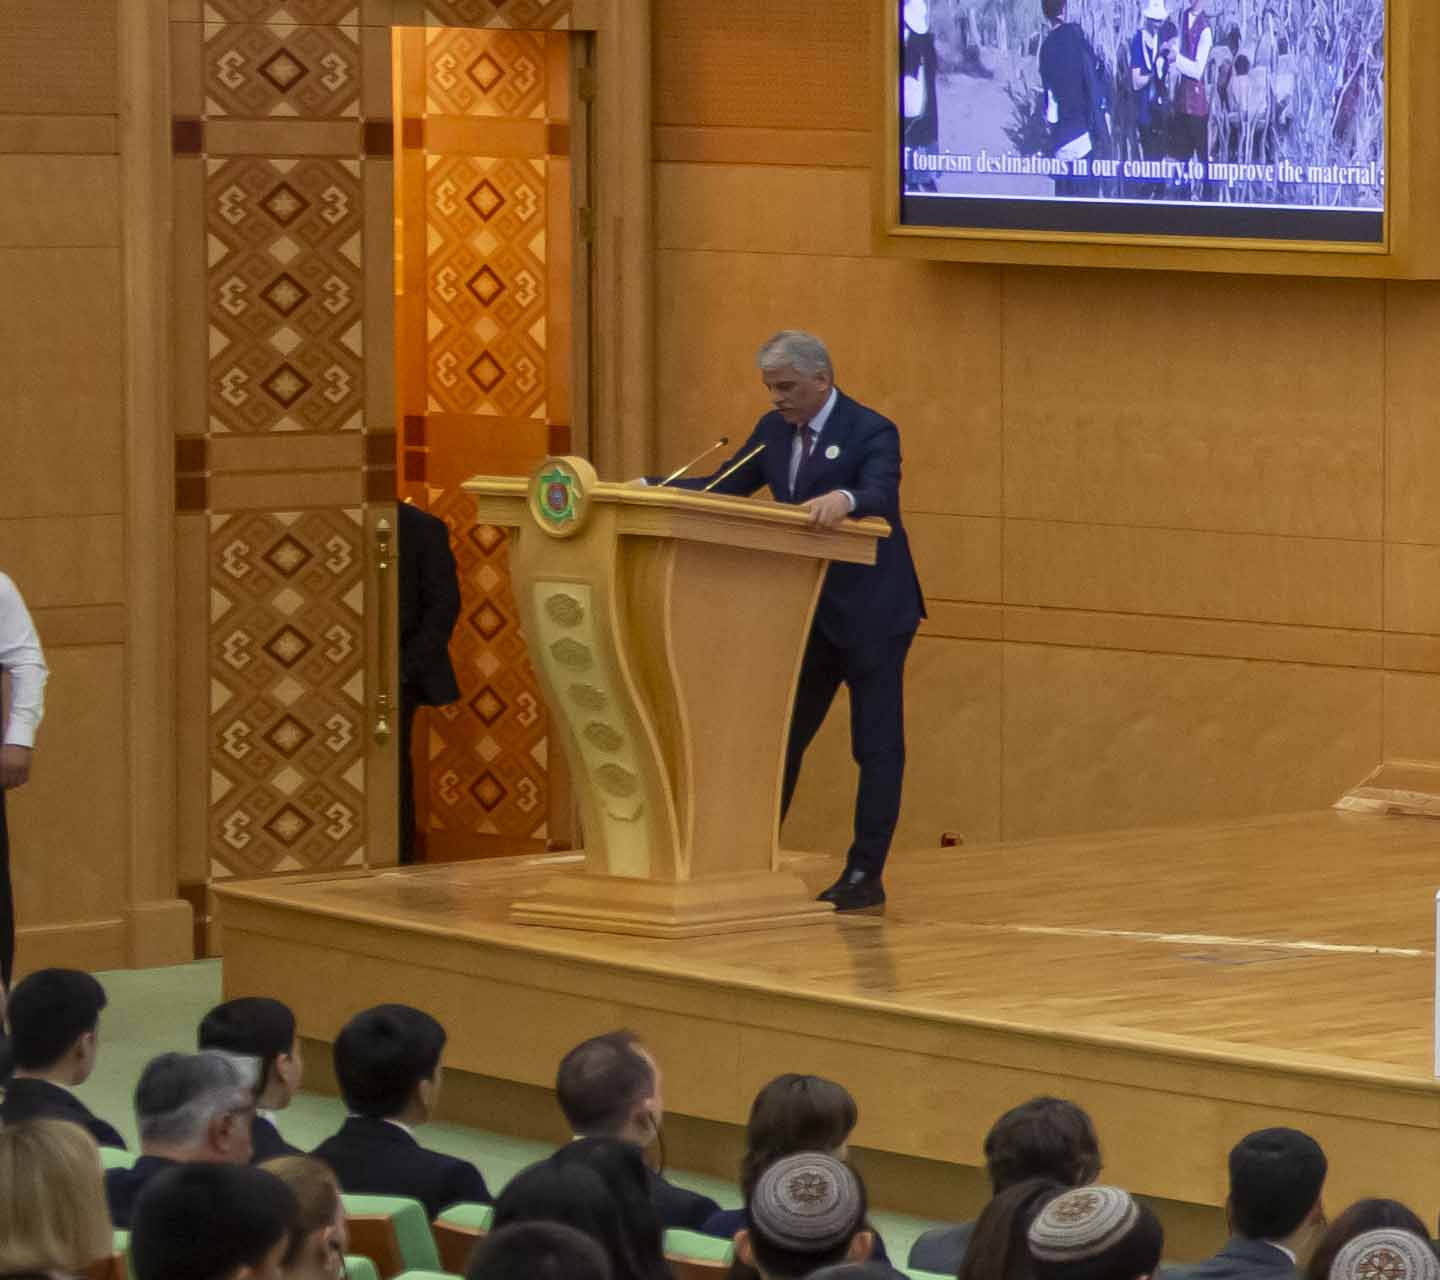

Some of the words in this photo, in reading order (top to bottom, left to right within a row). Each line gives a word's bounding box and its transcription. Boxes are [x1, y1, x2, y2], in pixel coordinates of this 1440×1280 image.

[913, 149, 972, 172] tourism
[976, 149, 1068, 177] destinations
[1073, 154, 1088, 176] in
[1092, 161, 1118, 177] our
[1207, 158, 1274, 187] improve
[1279, 158, 1303, 183] the
[1307, 161, 1376, 185] material
